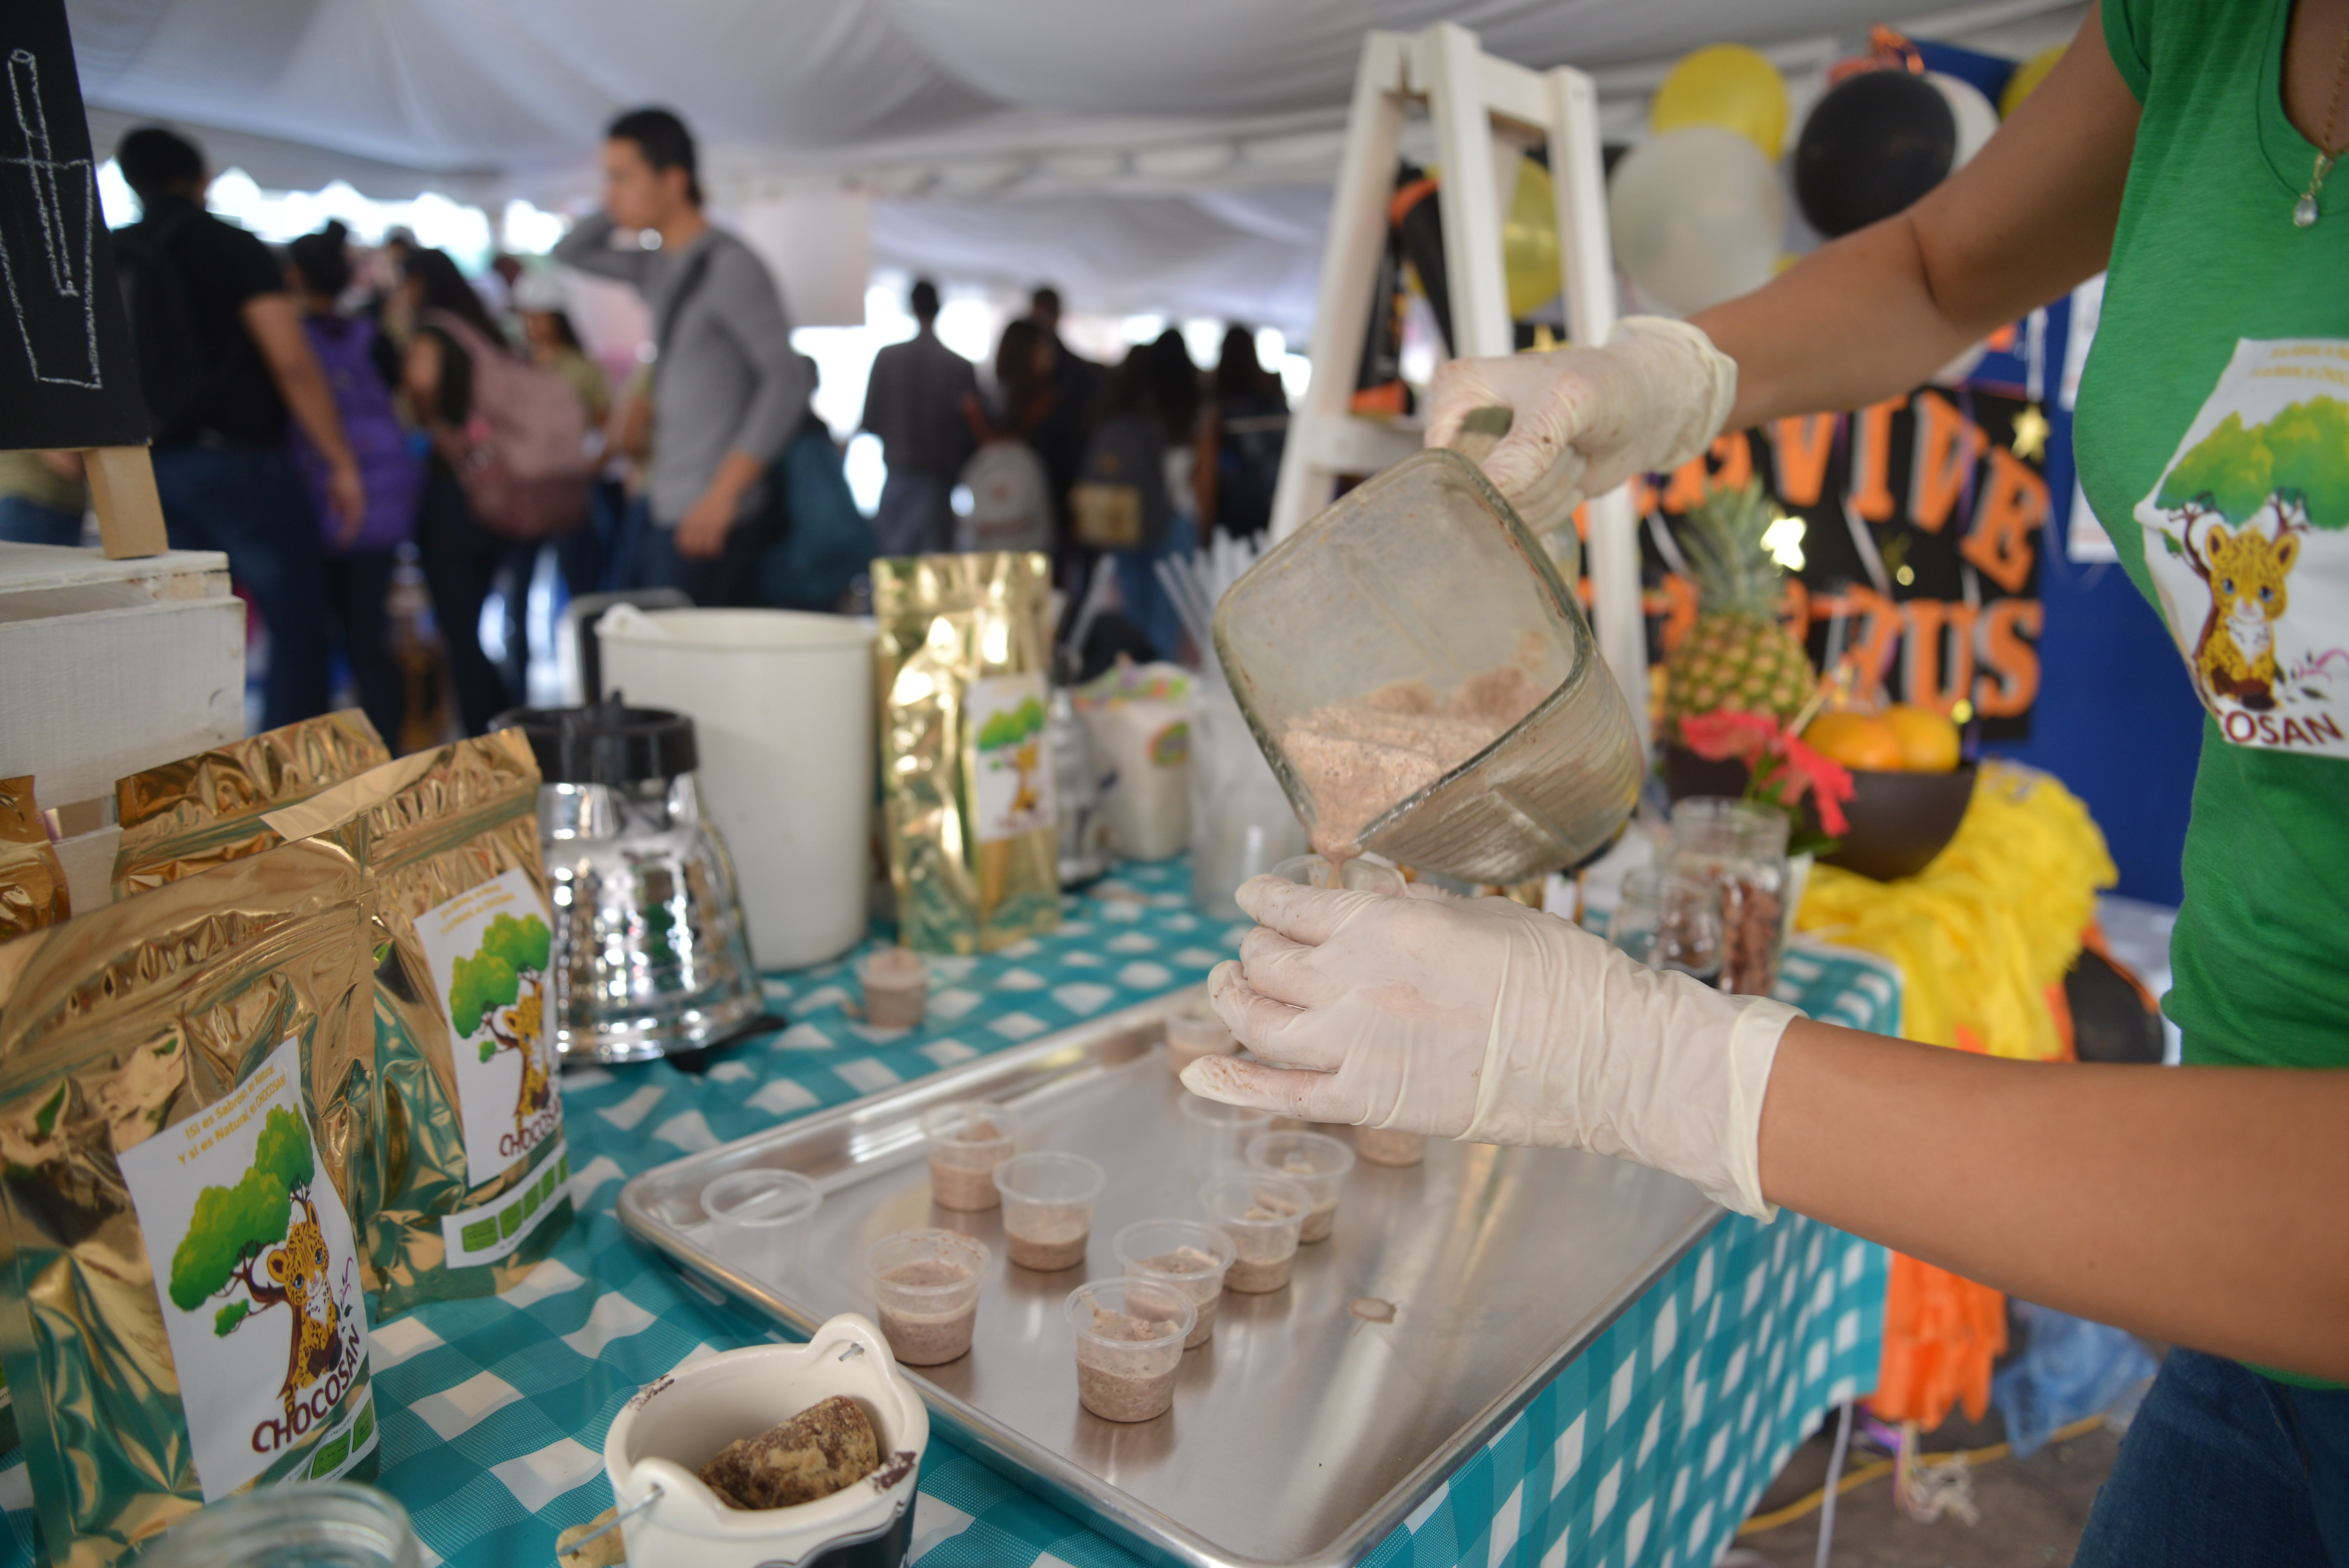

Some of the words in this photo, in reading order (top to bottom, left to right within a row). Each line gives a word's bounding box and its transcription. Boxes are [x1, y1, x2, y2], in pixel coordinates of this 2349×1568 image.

[2216, 710, 2345, 746] OSAN
[202, 1115, 214, 1129] es
[248, 1081, 255, 1092] es
[177, 1152, 186, 1166] Y
[189, 1144, 200, 1160] si
[200, 1137, 214, 1151] es
[249, 1102, 257, 1115] es
[252, 1323, 360, 1453] CHOCOSAN
